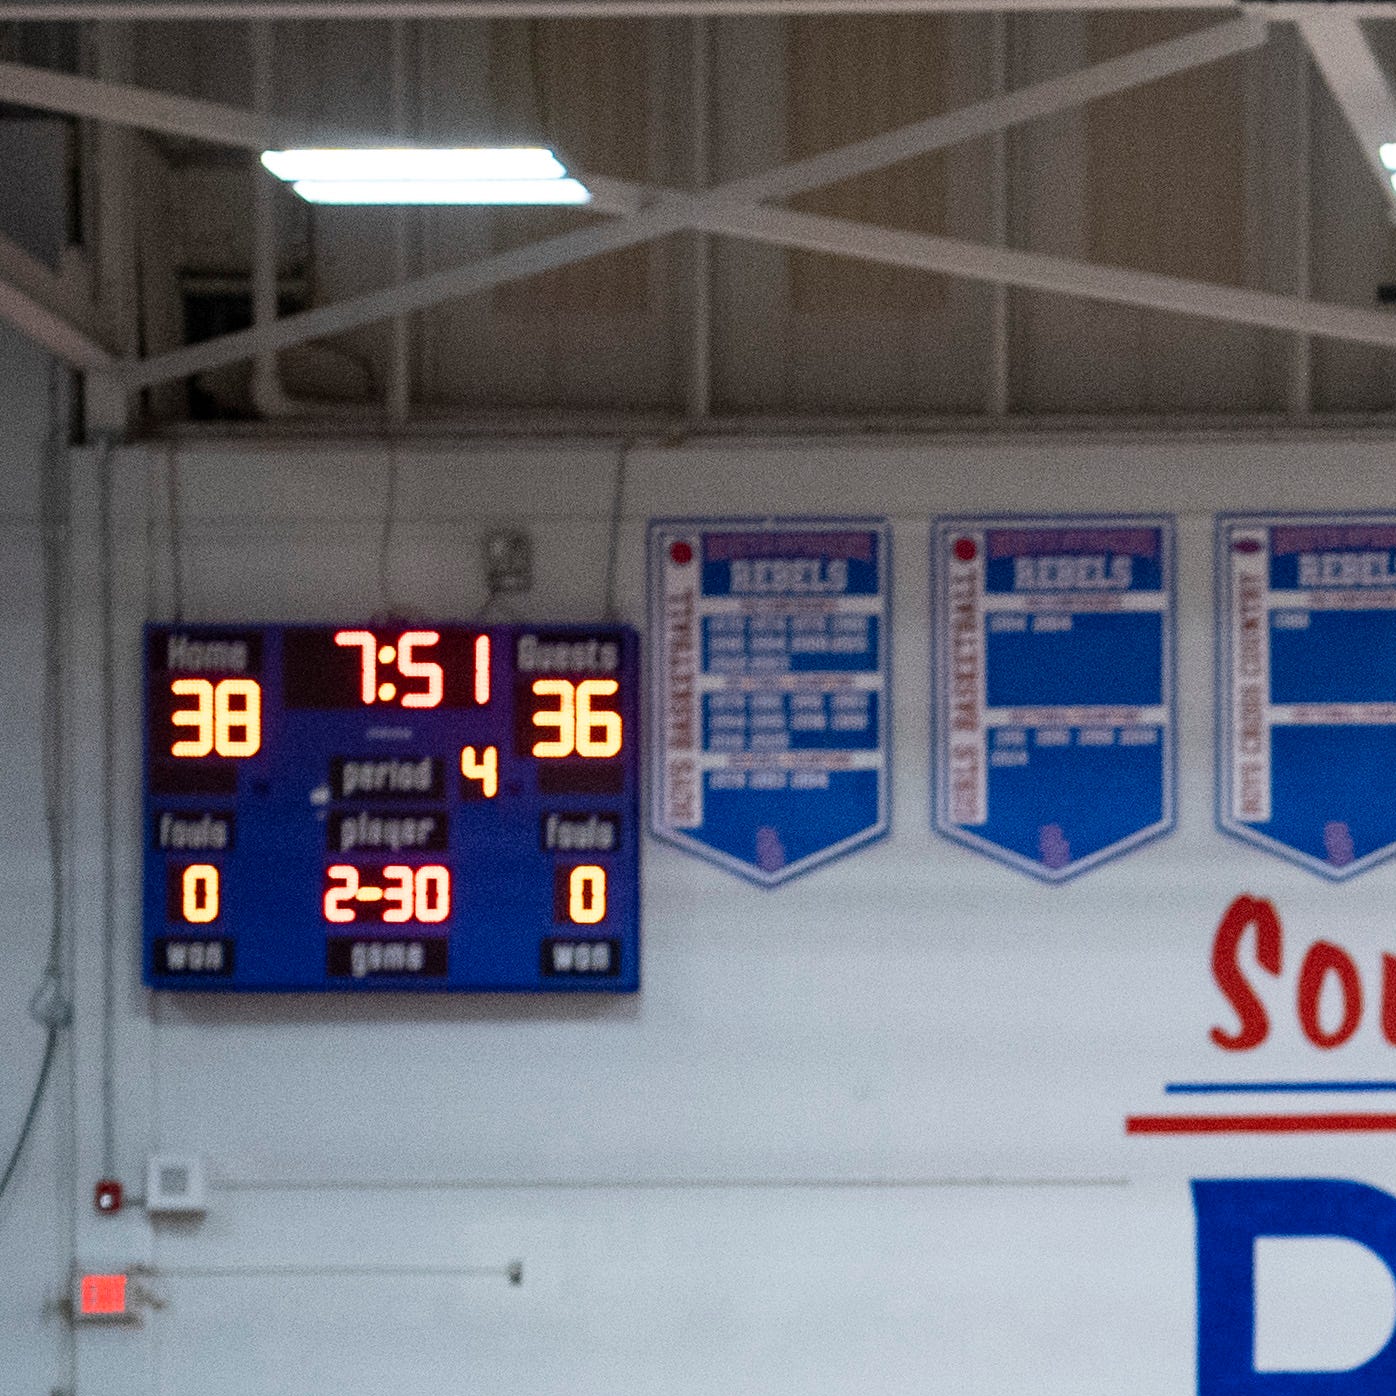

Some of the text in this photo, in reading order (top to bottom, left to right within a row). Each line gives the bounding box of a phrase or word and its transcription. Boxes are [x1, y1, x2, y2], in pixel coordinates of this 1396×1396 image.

[731, 558, 849, 592] REBELS
[1014, 555, 1132, 588] REBELS
[167, 634, 249, 672] Home
[334, 629, 491, 708] 7:51
[517, 634, 619, 672] Guests
[170, 678, 261, 757] 38
[532, 678, 622, 757] 36
[341, 757, 434, 795] period
[460, 744, 498, 798] 4
[340, 810, 436, 852] player
[181, 863, 220, 924] 0
[323, 864, 451, 924] 2-30
[568, 864, 607, 925] 0
